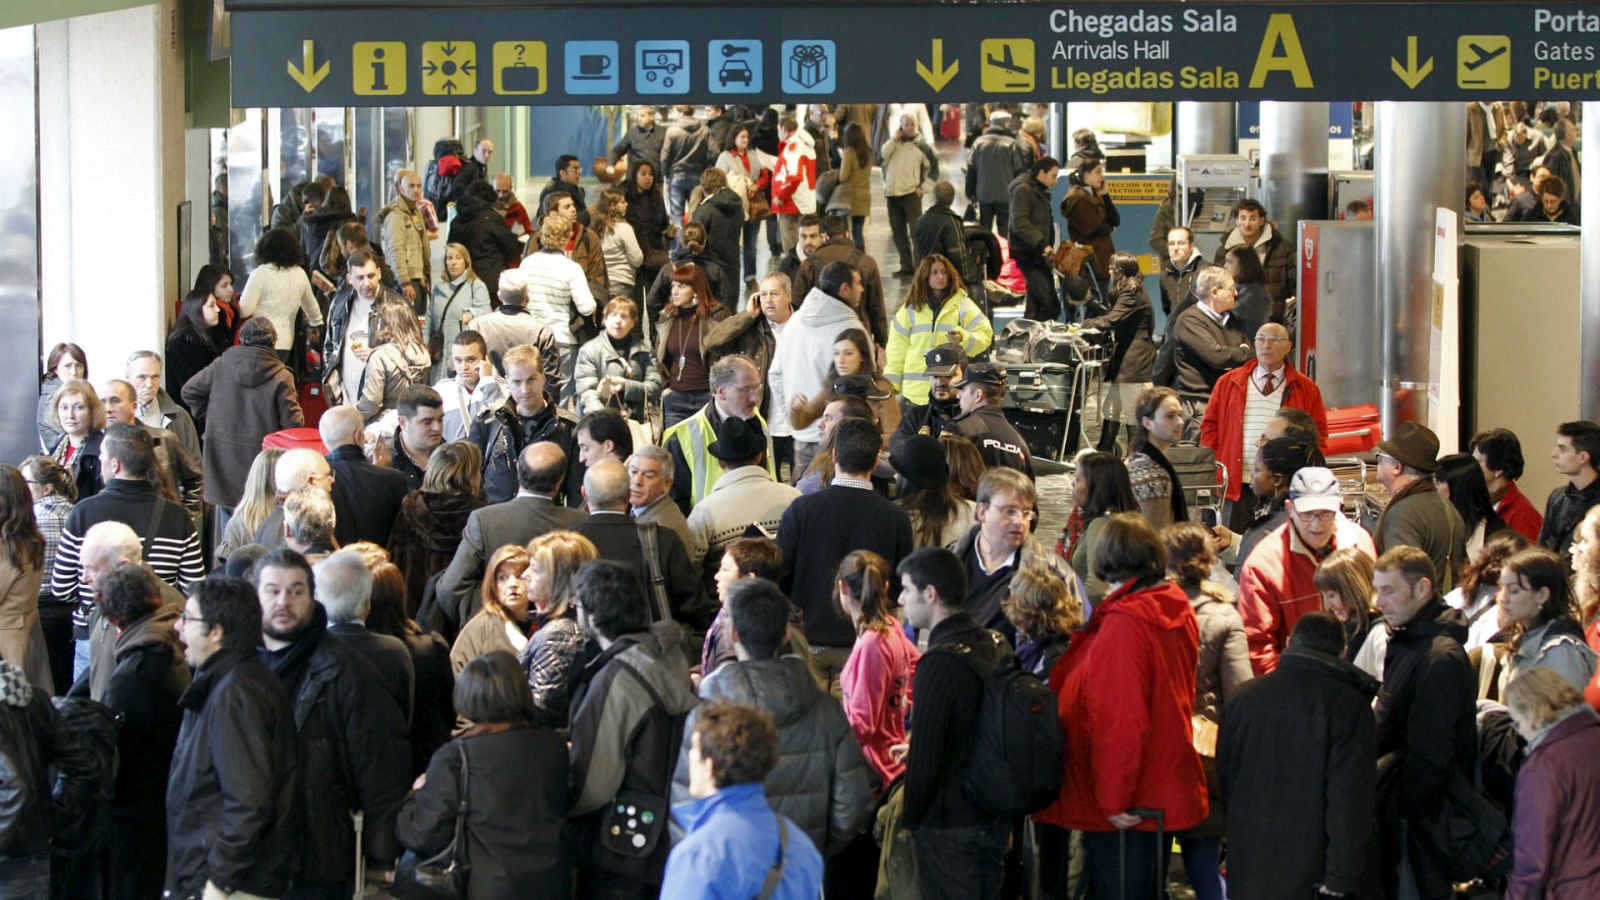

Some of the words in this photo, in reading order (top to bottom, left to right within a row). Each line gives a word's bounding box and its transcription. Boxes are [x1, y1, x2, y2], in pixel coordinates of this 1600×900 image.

[1049, 9, 1173, 38] Chegadas
[1182, 9, 1237, 33] Sala
[1534, 9, 1600, 32] Porta
[1052, 40, 1129, 60] Arrivals
[1134, 40, 1170, 60] Hall
[1248, 13, 1314, 88] A
[1534, 40, 1595, 61] Gates
[1051, 66, 1174, 94] Llegadas
[1179, 66, 1239, 89] Sala
[1534, 67, 1600, 90] Puert
